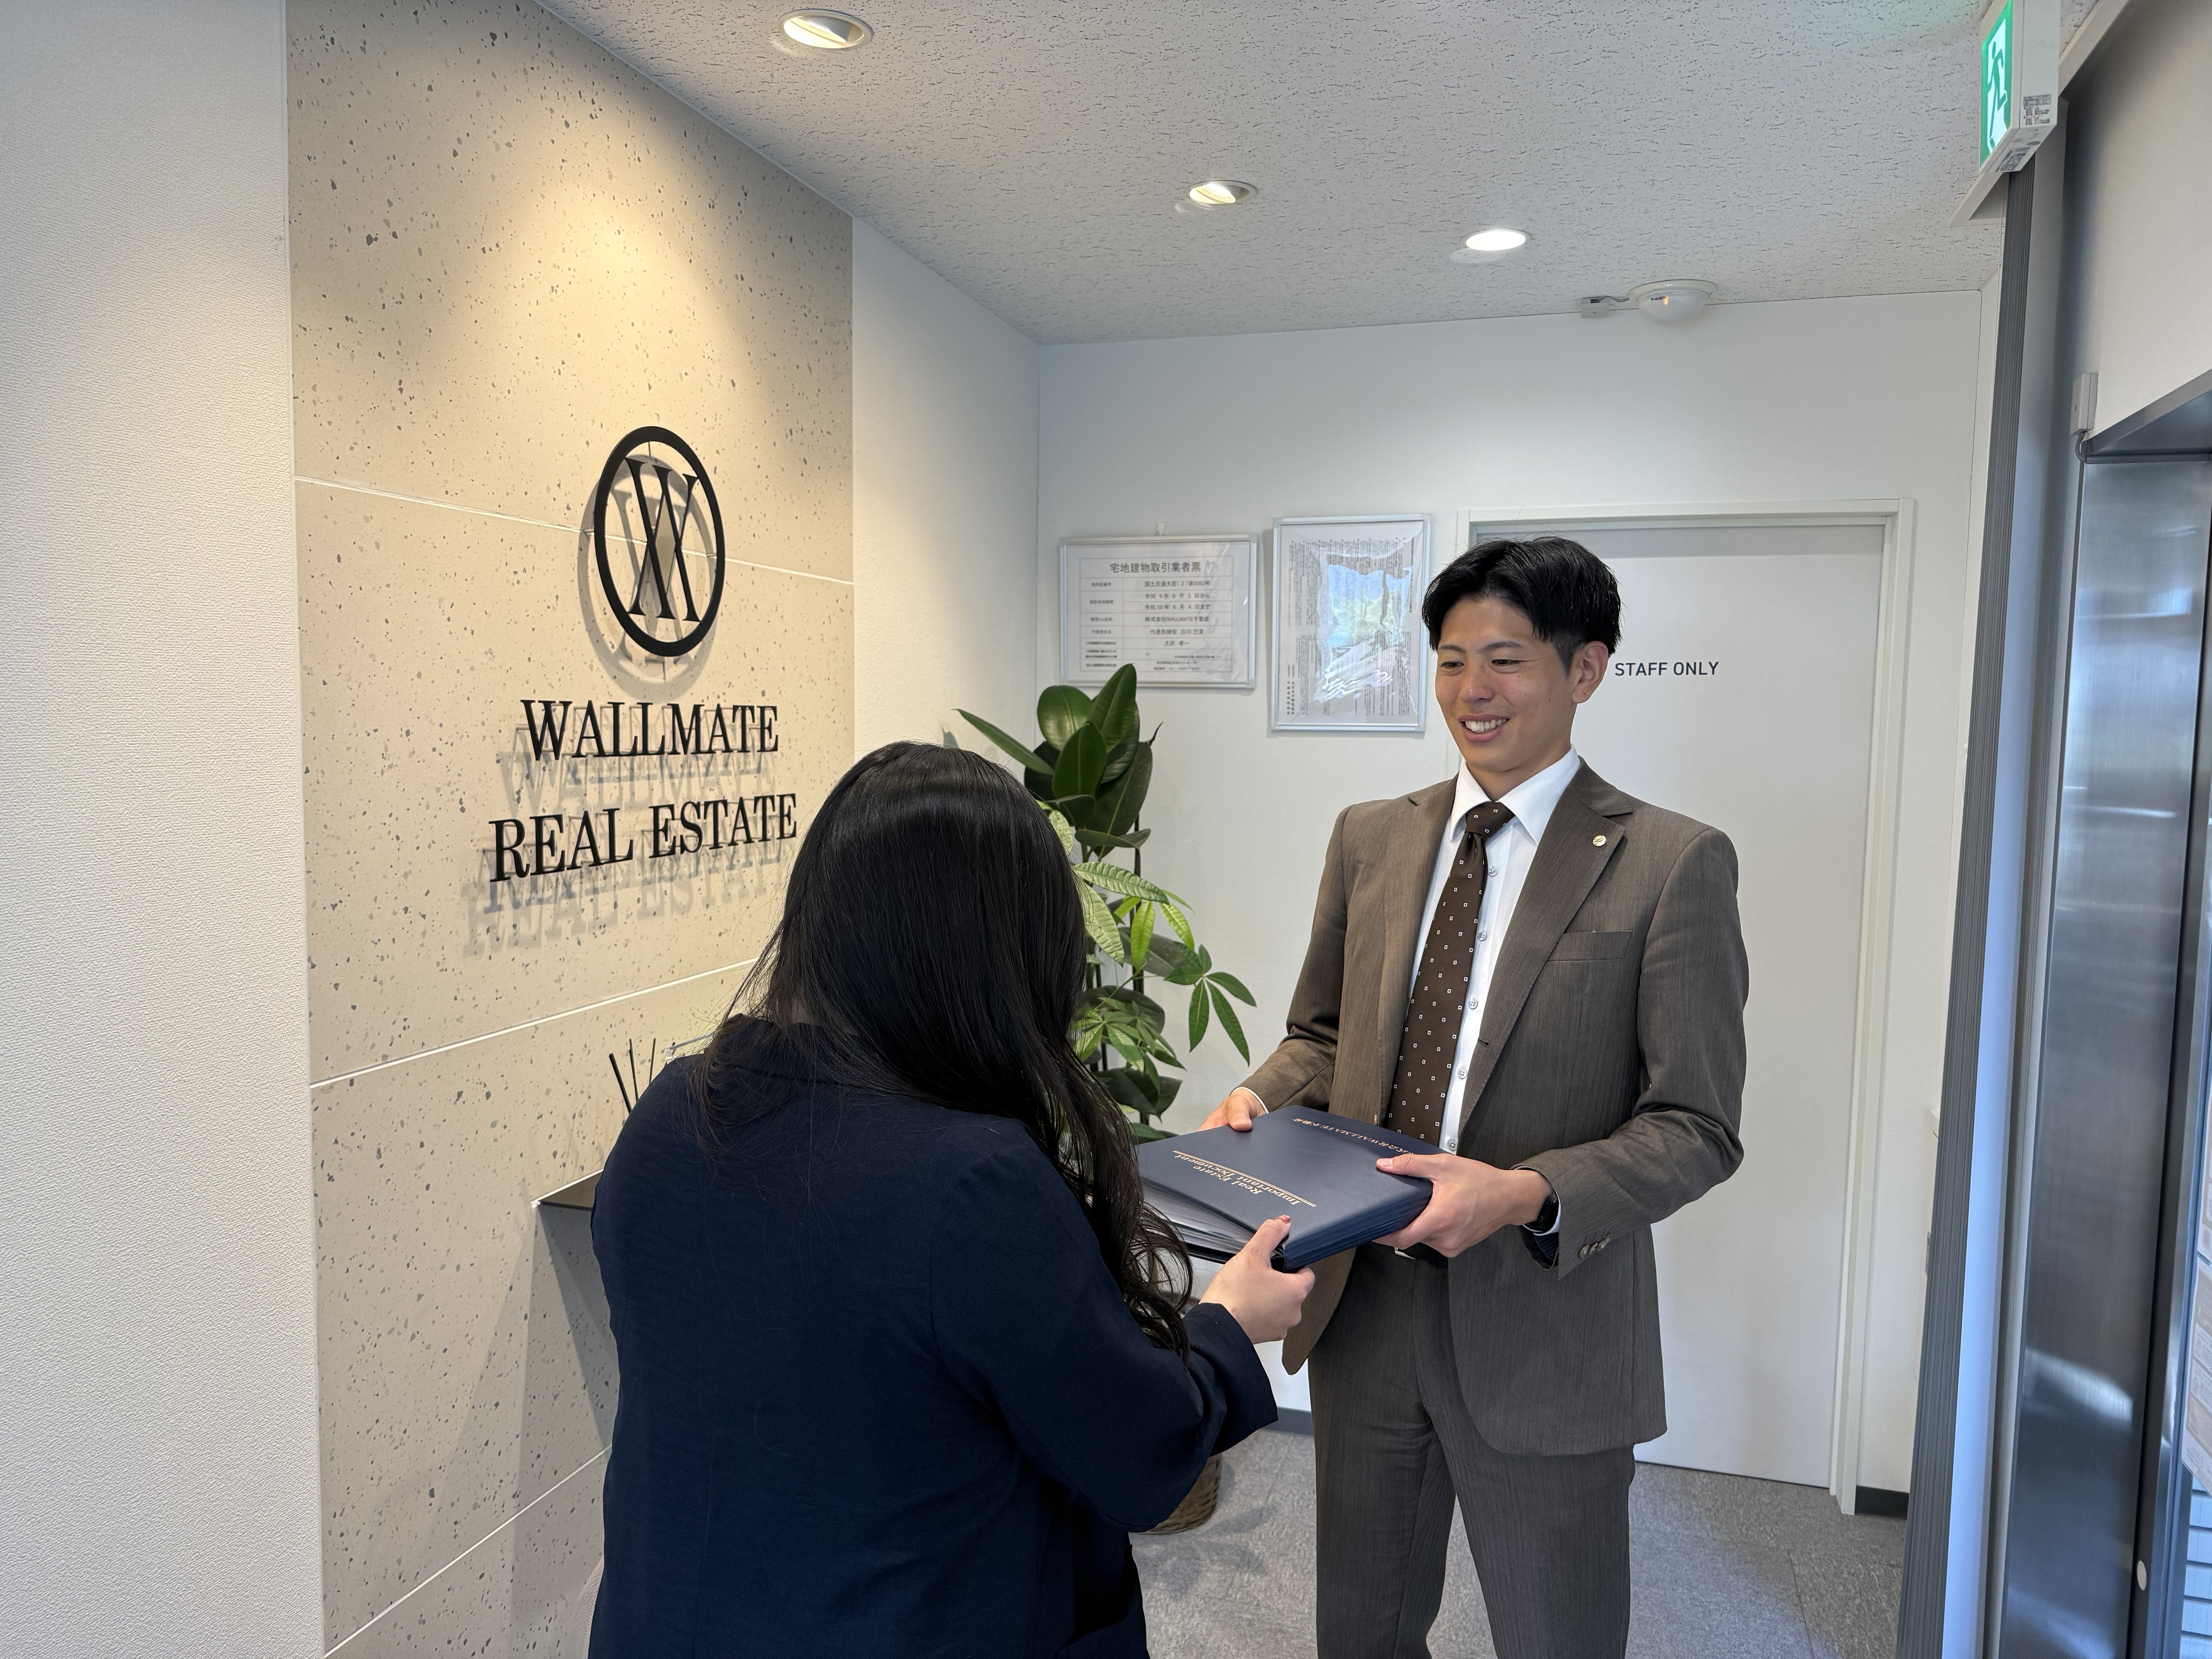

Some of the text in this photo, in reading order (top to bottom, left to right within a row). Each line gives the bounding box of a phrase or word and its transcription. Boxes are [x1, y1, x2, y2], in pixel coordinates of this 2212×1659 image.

[1110, 562, 1201, 573] 宅地建物取引業者票
[1614, 661, 1719, 676] STAFF ONLY
[520, 699, 779, 761] WALLMATE
[488, 792, 797, 883] REAL ESTATE
[1174, 1154, 1301, 1206] Important Document
[1193, 1165, 1263, 1195] Real Estate
